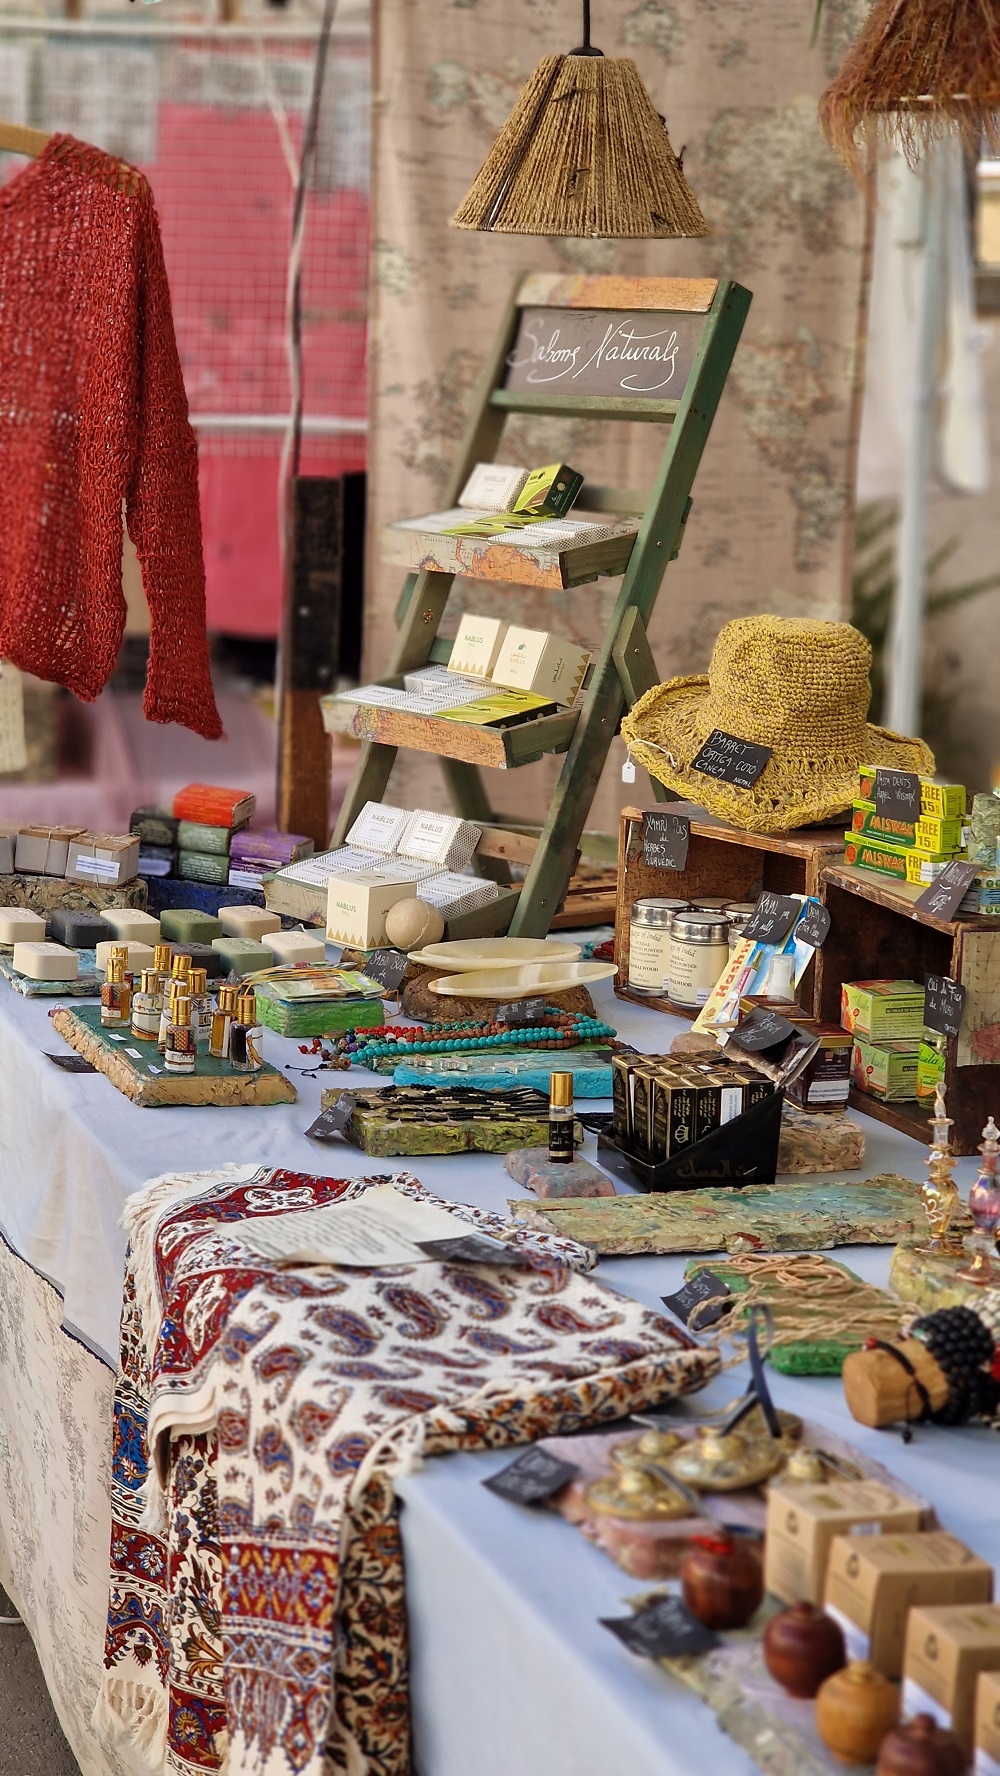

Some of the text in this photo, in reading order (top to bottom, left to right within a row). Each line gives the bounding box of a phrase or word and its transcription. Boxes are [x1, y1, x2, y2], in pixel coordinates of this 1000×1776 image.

[572, 319, 680, 391] Naturals
[464, 634, 484, 644] NABLUS
[695, 760, 726, 779] CANEM
[732, 776, 752, 788] NEPAL
[921, 784, 940, 802] FREE
[921, 801, 935, 813] 15
[371, 813, 395, 825] NABLUS
[419, 822, 444, 834] NABLUS
[869, 815, 914, 838] MISWAK
[917, 822, 939, 837] FREE
[917, 836, 931, 848] 15
[861, 849, 906, 872] MISWAK
[335, 901, 357, 913] NABLUS
[647, 932, 661, 942] India
[643, 946, 664, 954] POWDER
